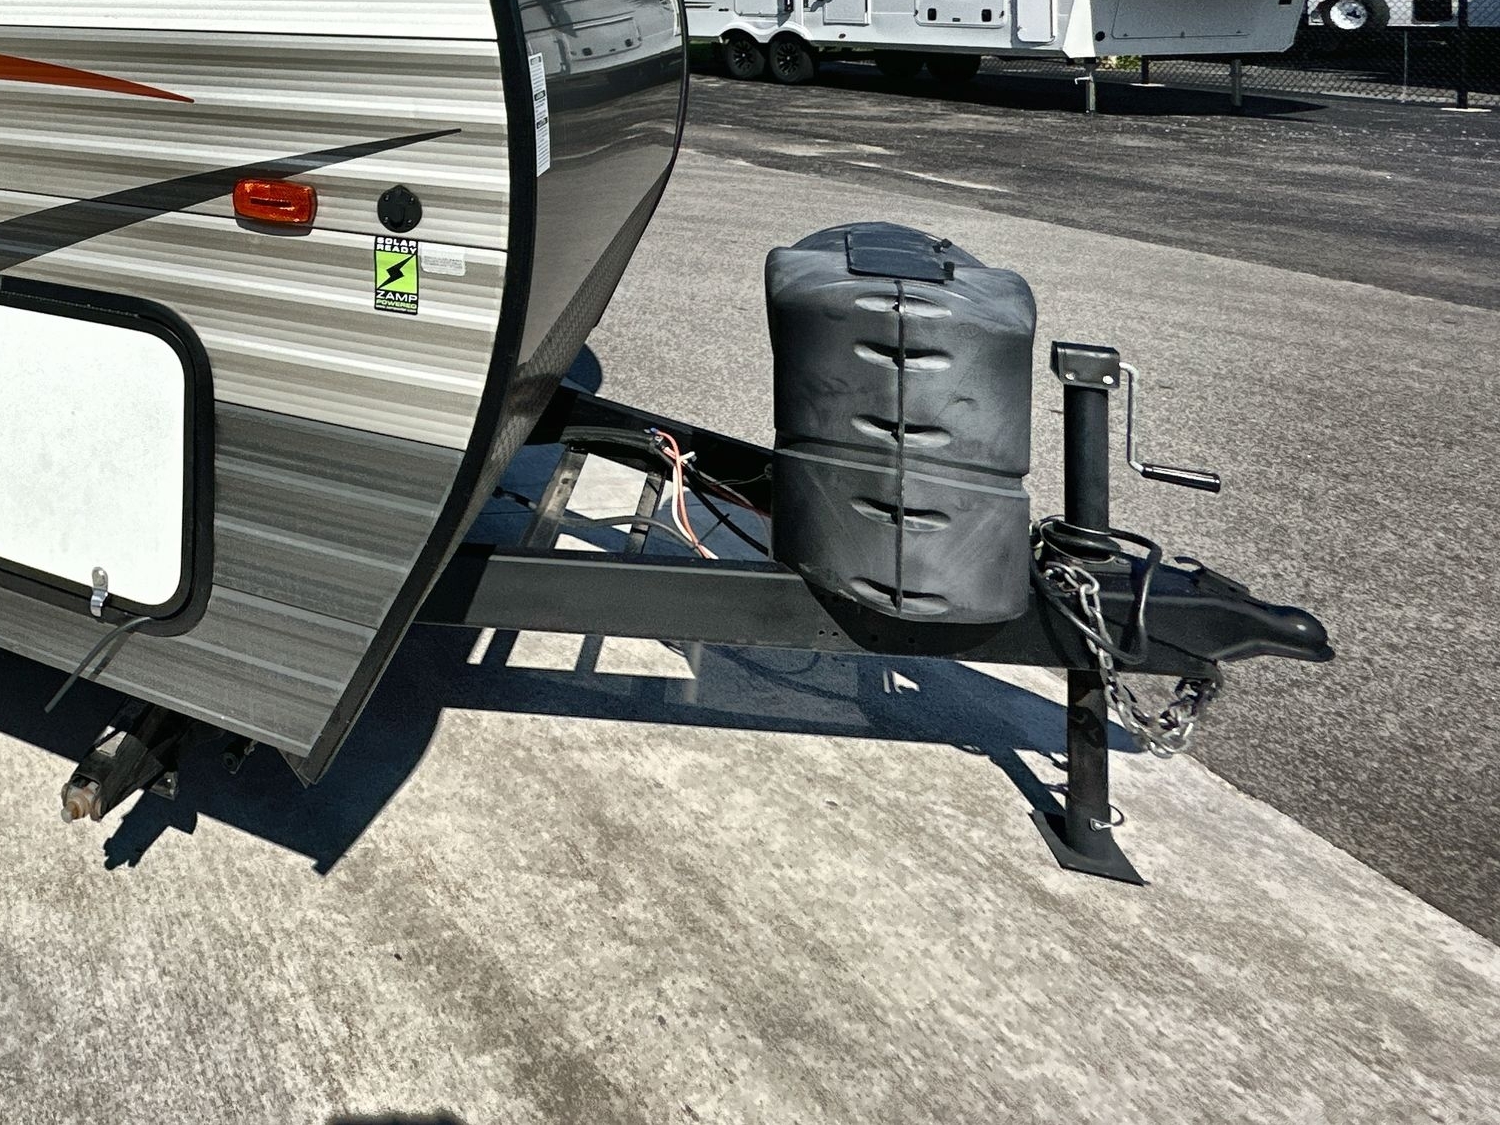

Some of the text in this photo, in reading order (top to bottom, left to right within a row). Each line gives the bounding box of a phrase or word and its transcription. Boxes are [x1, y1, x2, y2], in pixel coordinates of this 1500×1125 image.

[376, 236, 417, 248] SOLAR
[376, 243, 417, 255] READY
[376, 290, 418, 303] ZAMP
[376, 299, 417, 310] POWERED
